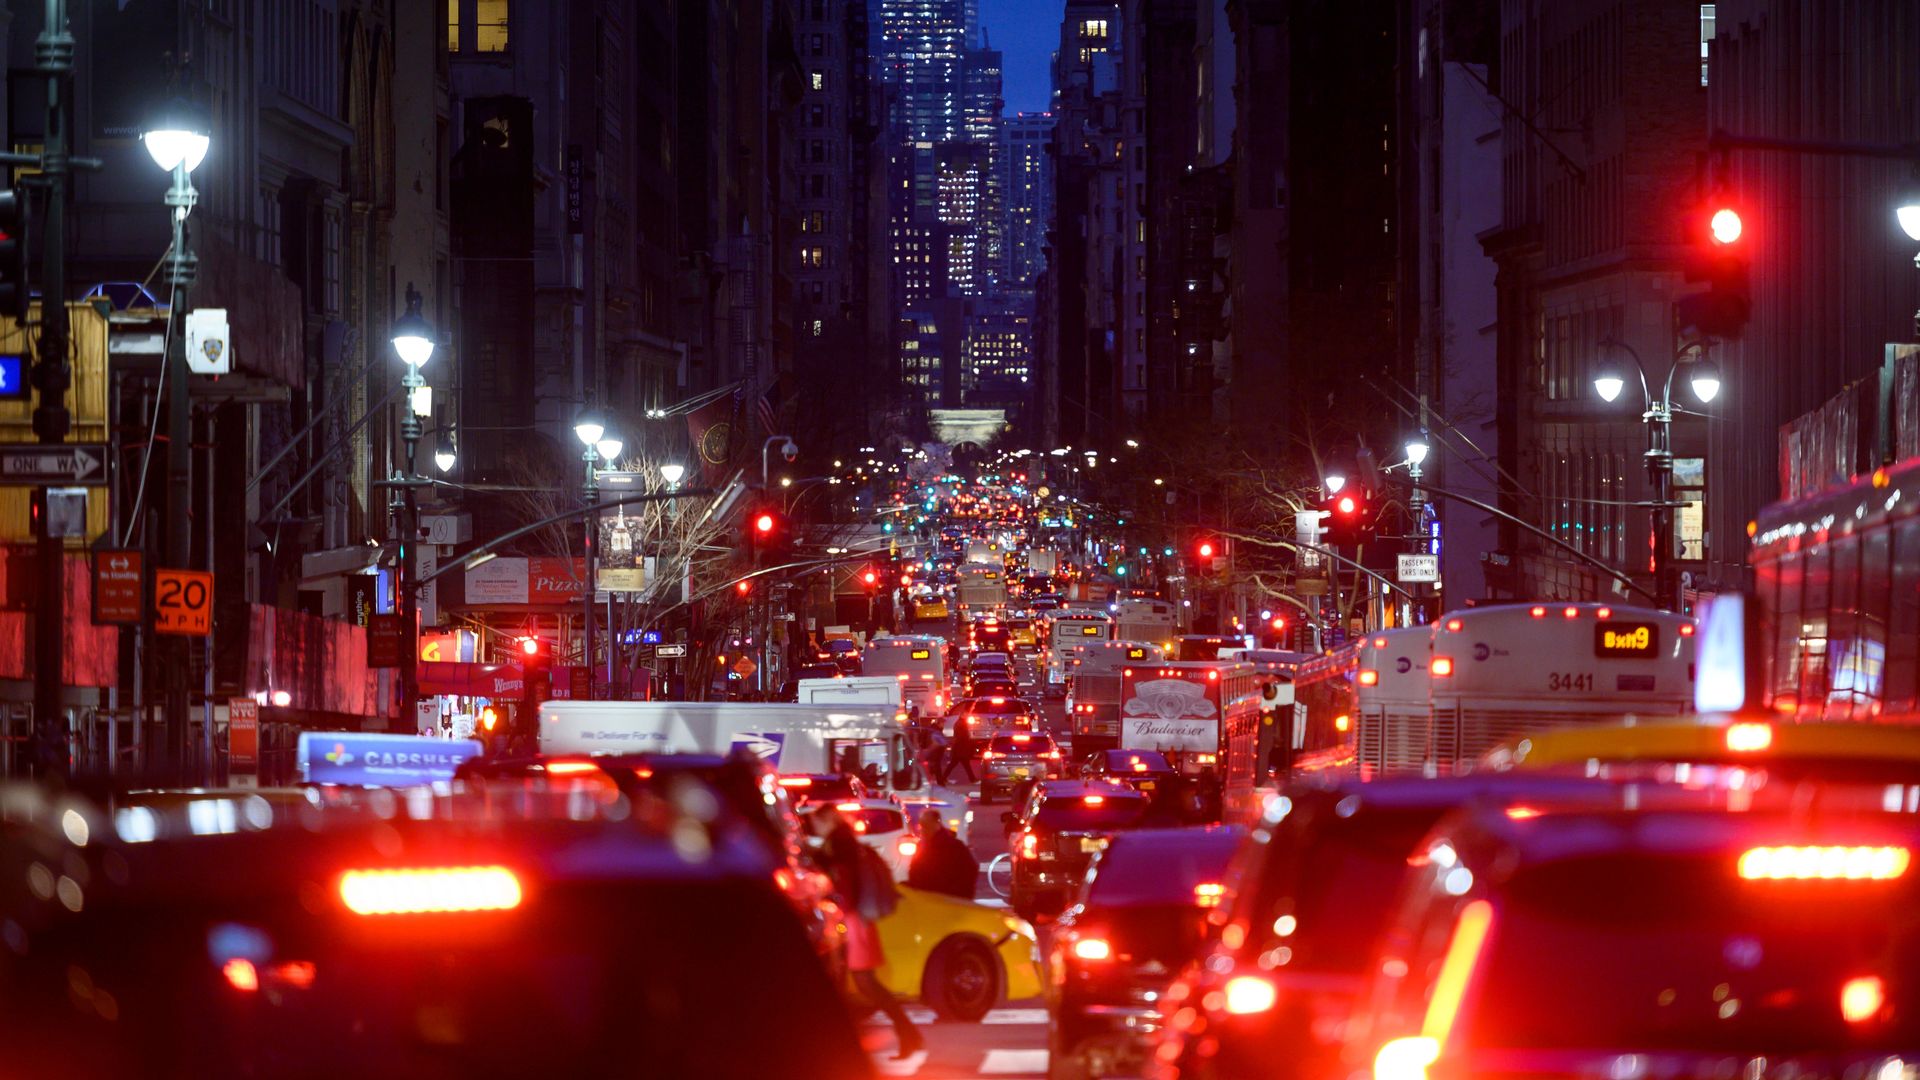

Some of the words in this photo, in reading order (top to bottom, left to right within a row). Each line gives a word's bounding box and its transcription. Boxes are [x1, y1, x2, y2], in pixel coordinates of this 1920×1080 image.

[12, 455, 38, 472] ONE
[57, 455, 89, 472] WAY
[1420, 569, 1435, 577] ONLY
[160, 579, 206, 610] 20
[1549, 672, 1593, 692] 3441
[1133, 719, 1205, 736] Budweiser
